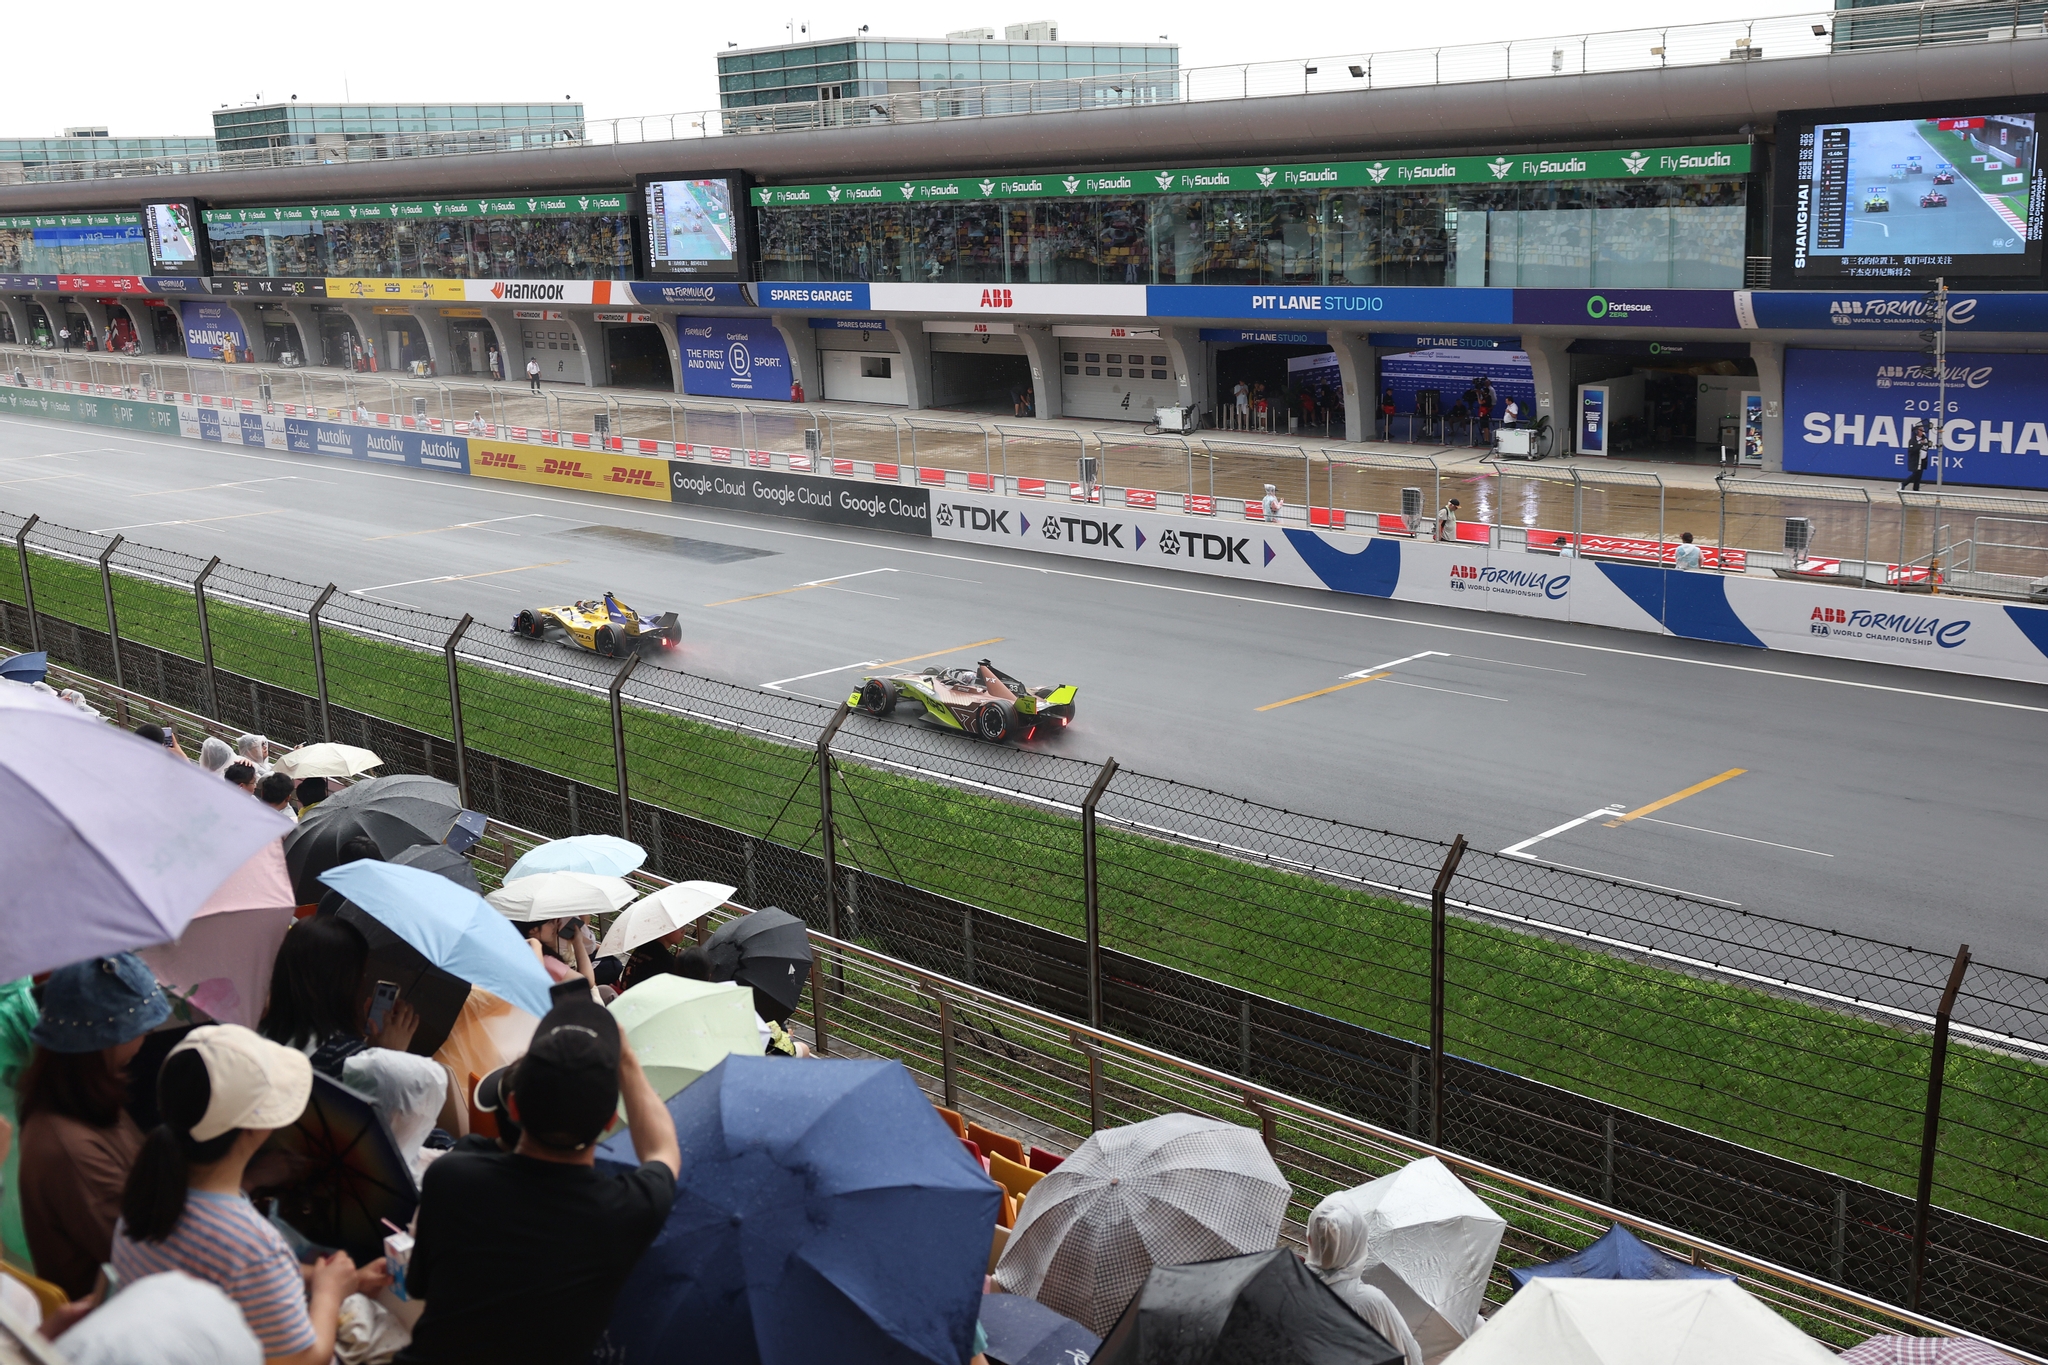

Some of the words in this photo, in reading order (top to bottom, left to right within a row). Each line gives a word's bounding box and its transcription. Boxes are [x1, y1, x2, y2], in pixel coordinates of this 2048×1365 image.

[1953, 119, 1969, 128] ABB
[1522, 157, 1586, 177] FlySaudia
[1660, 151, 1731, 171] FlySaudia
[1285, 167, 1338, 185] FlySaudia
[1398, 163, 1456, 181] FlySaudia
[1001, 179, 1042, 194] FlySaudia
[1086, 176, 1132, 192] FlySaudia
[1181, 172, 1230, 189] FlySaudia
[776, 189, 810, 202] FlySaudia
[846, 186, 882, 201] FlySaudia
[920, 184, 959, 198] FlySaudia
[2035, 168, 2043, 216] CHAMPIONSHIP
[491, 201, 515, 213] FlySaudia
[540, 199, 566, 211] FlySaudia
[592, 197, 620, 210] FlySaudia
[1794, 184, 1809, 268] SHANGHAI
[647, 217, 656, 268] SHANGHAI
[294, 281, 305, 293] 33
[350, 282, 360, 294] 22
[771, 290, 809, 301] SPARES
[812, 290, 853, 302] GARAGE
[980, 289, 1013, 307] ABB
[1252, 296, 1276, 309] PIT
[1279, 296, 1321, 310] LANE
[1324, 296, 1383, 311] STUDIO
[1830, 301, 1863, 314] ABB
[858, 321, 882, 330] GARAGE
[974, 324, 987, 332] ABB
[1110, 328, 1125, 337] ABB
[727, 333, 748, 341] Certified
[1241, 332, 1255, 340] PIT
[1255, 333, 1277, 342] LANE
[1278, 334, 1307, 342] STUDIO
[1417, 338, 1432, 346] PIT
[1433, 338, 1458, 347] LANE
[1459, 339, 1493, 348] STUDIO
[687, 348, 702, 358] THE
[703, 350, 724, 359] FIRST
[734, 350, 744, 369] B
[688, 360, 704, 369] AND
[706, 361, 725, 370] ONLY
[754, 357, 781, 367] SPORT.
[1877, 366, 1904, 377] ABB
[1121, 391, 1131, 410] 4
[85, 403, 98, 418] PIF
[121, 407, 133, 422] PIF
[158, 411, 171, 427] PIF
[316, 428, 351, 446] Autoliv
[366, 434, 404, 452] Autoliv
[420, 440, 460, 459] Autoliv
[481, 451, 519, 470] DHL
[543, 458, 585, 478] DHL
[611, 466, 656, 487] DHL
[673, 471, 712, 495] Google
[714, 477, 746, 496] Cloud
[752, 480, 795, 505] Google
[797, 486, 832, 507] Cloud
[839, 491, 886, 517] Google
[889, 497, 927, 519] Cloud
[953, 504, 1010, 534] TDK
[1060, 517, 1124, 549] TDK
[1180, 531, 1250, 565] TDK
[1450, 565, 1477, 579] ABB
[1479, 567, 1547, 589] FORMULA
[1468, 584, 1490, 592] WORLD
[1492, 587, 1543, 598] CHAMPIONSHIP
[1810, 606, 1847, 624] ABB
[1848, 610, 1939, 637] FORMULA
[1833, 629, 1863, 638] WORLD
[1865, 633, 1933, 646] CHAMPIONSHIP
[1009, 684, 1018, 692] 33
